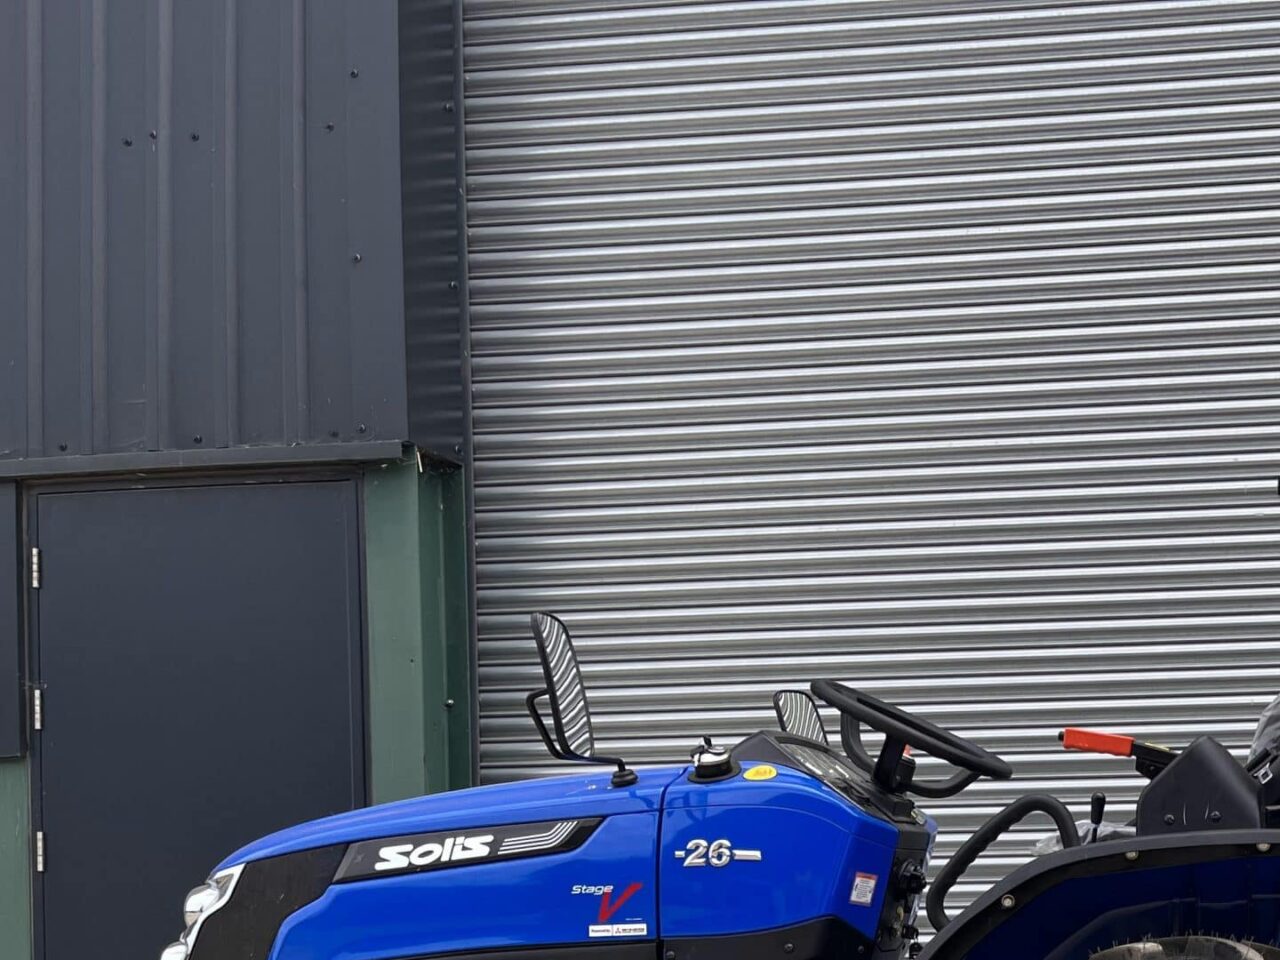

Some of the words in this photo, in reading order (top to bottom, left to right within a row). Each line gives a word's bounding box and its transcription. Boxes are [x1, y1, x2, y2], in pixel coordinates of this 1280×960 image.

[683, 839, 732, 867] 26
[571, 884, 614, 895] Stage
[598, 882, 643, 922] V
